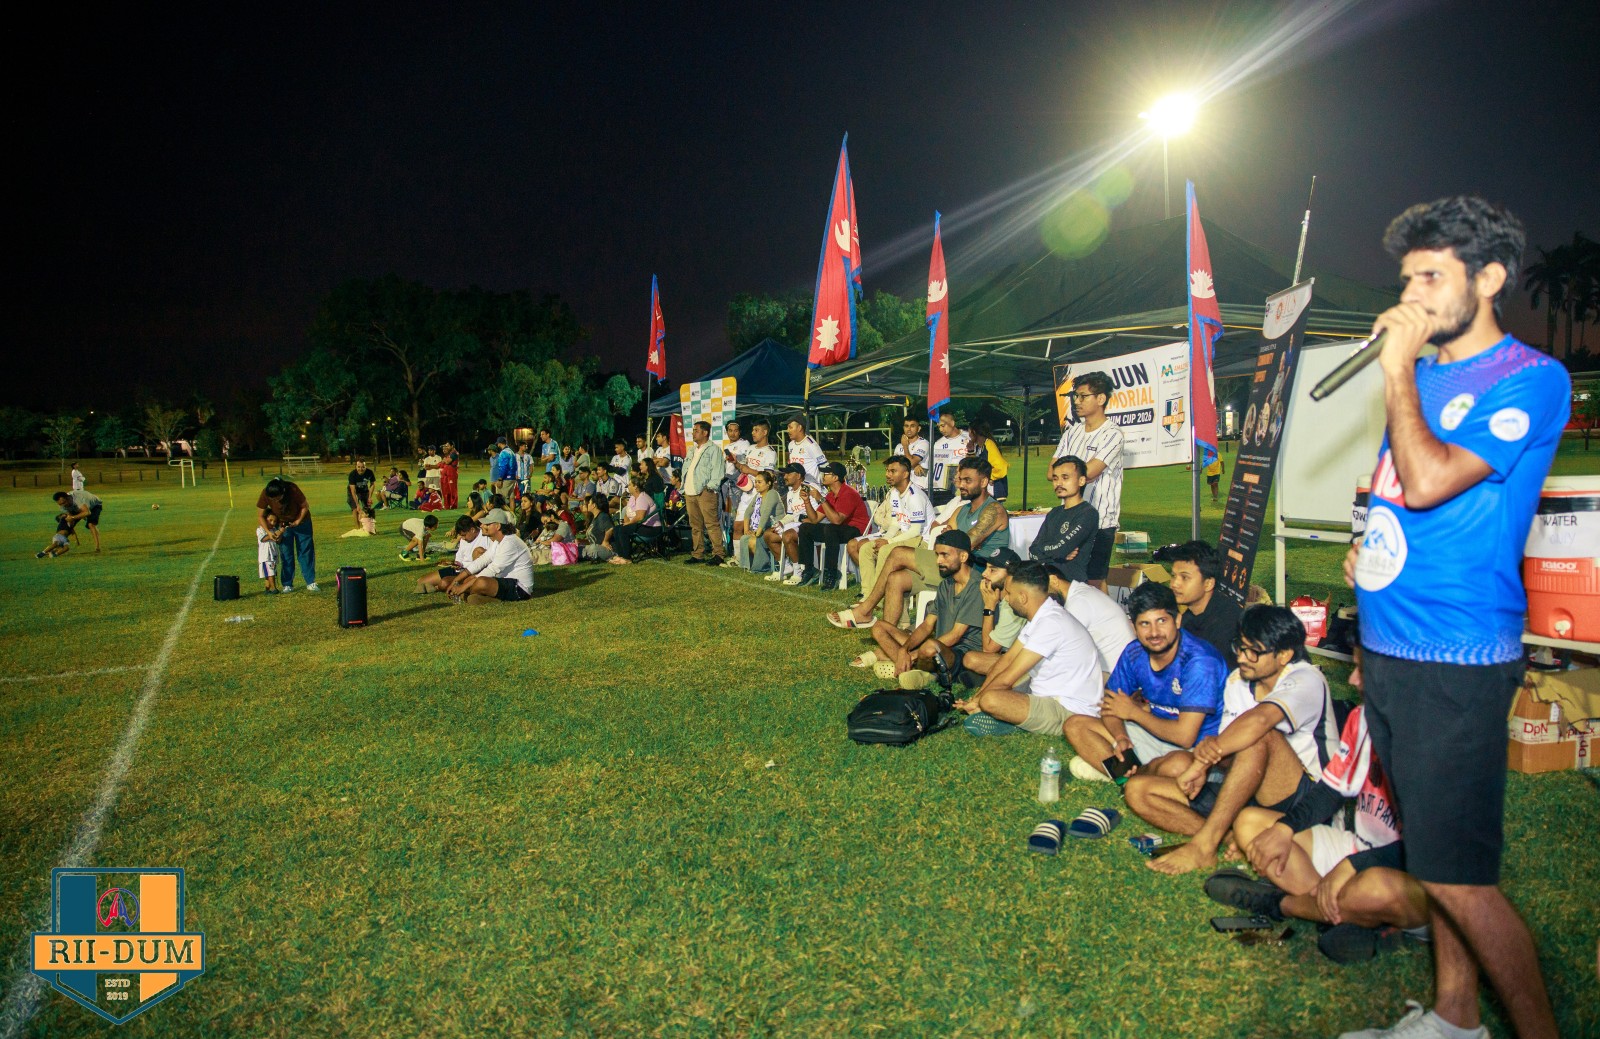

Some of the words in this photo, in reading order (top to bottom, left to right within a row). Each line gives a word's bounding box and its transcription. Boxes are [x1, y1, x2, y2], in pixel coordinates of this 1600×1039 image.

[1112, 362, 1149, 390] JUN
[1105, 386, 1155, 411] MORIAL
[1122, 413, 1137, 425] CUP
[1137, 410, 1153, 423] 2026
[1543, 515, 1578, 526] WATER
[1578, 739, 1588, 757] Dp
